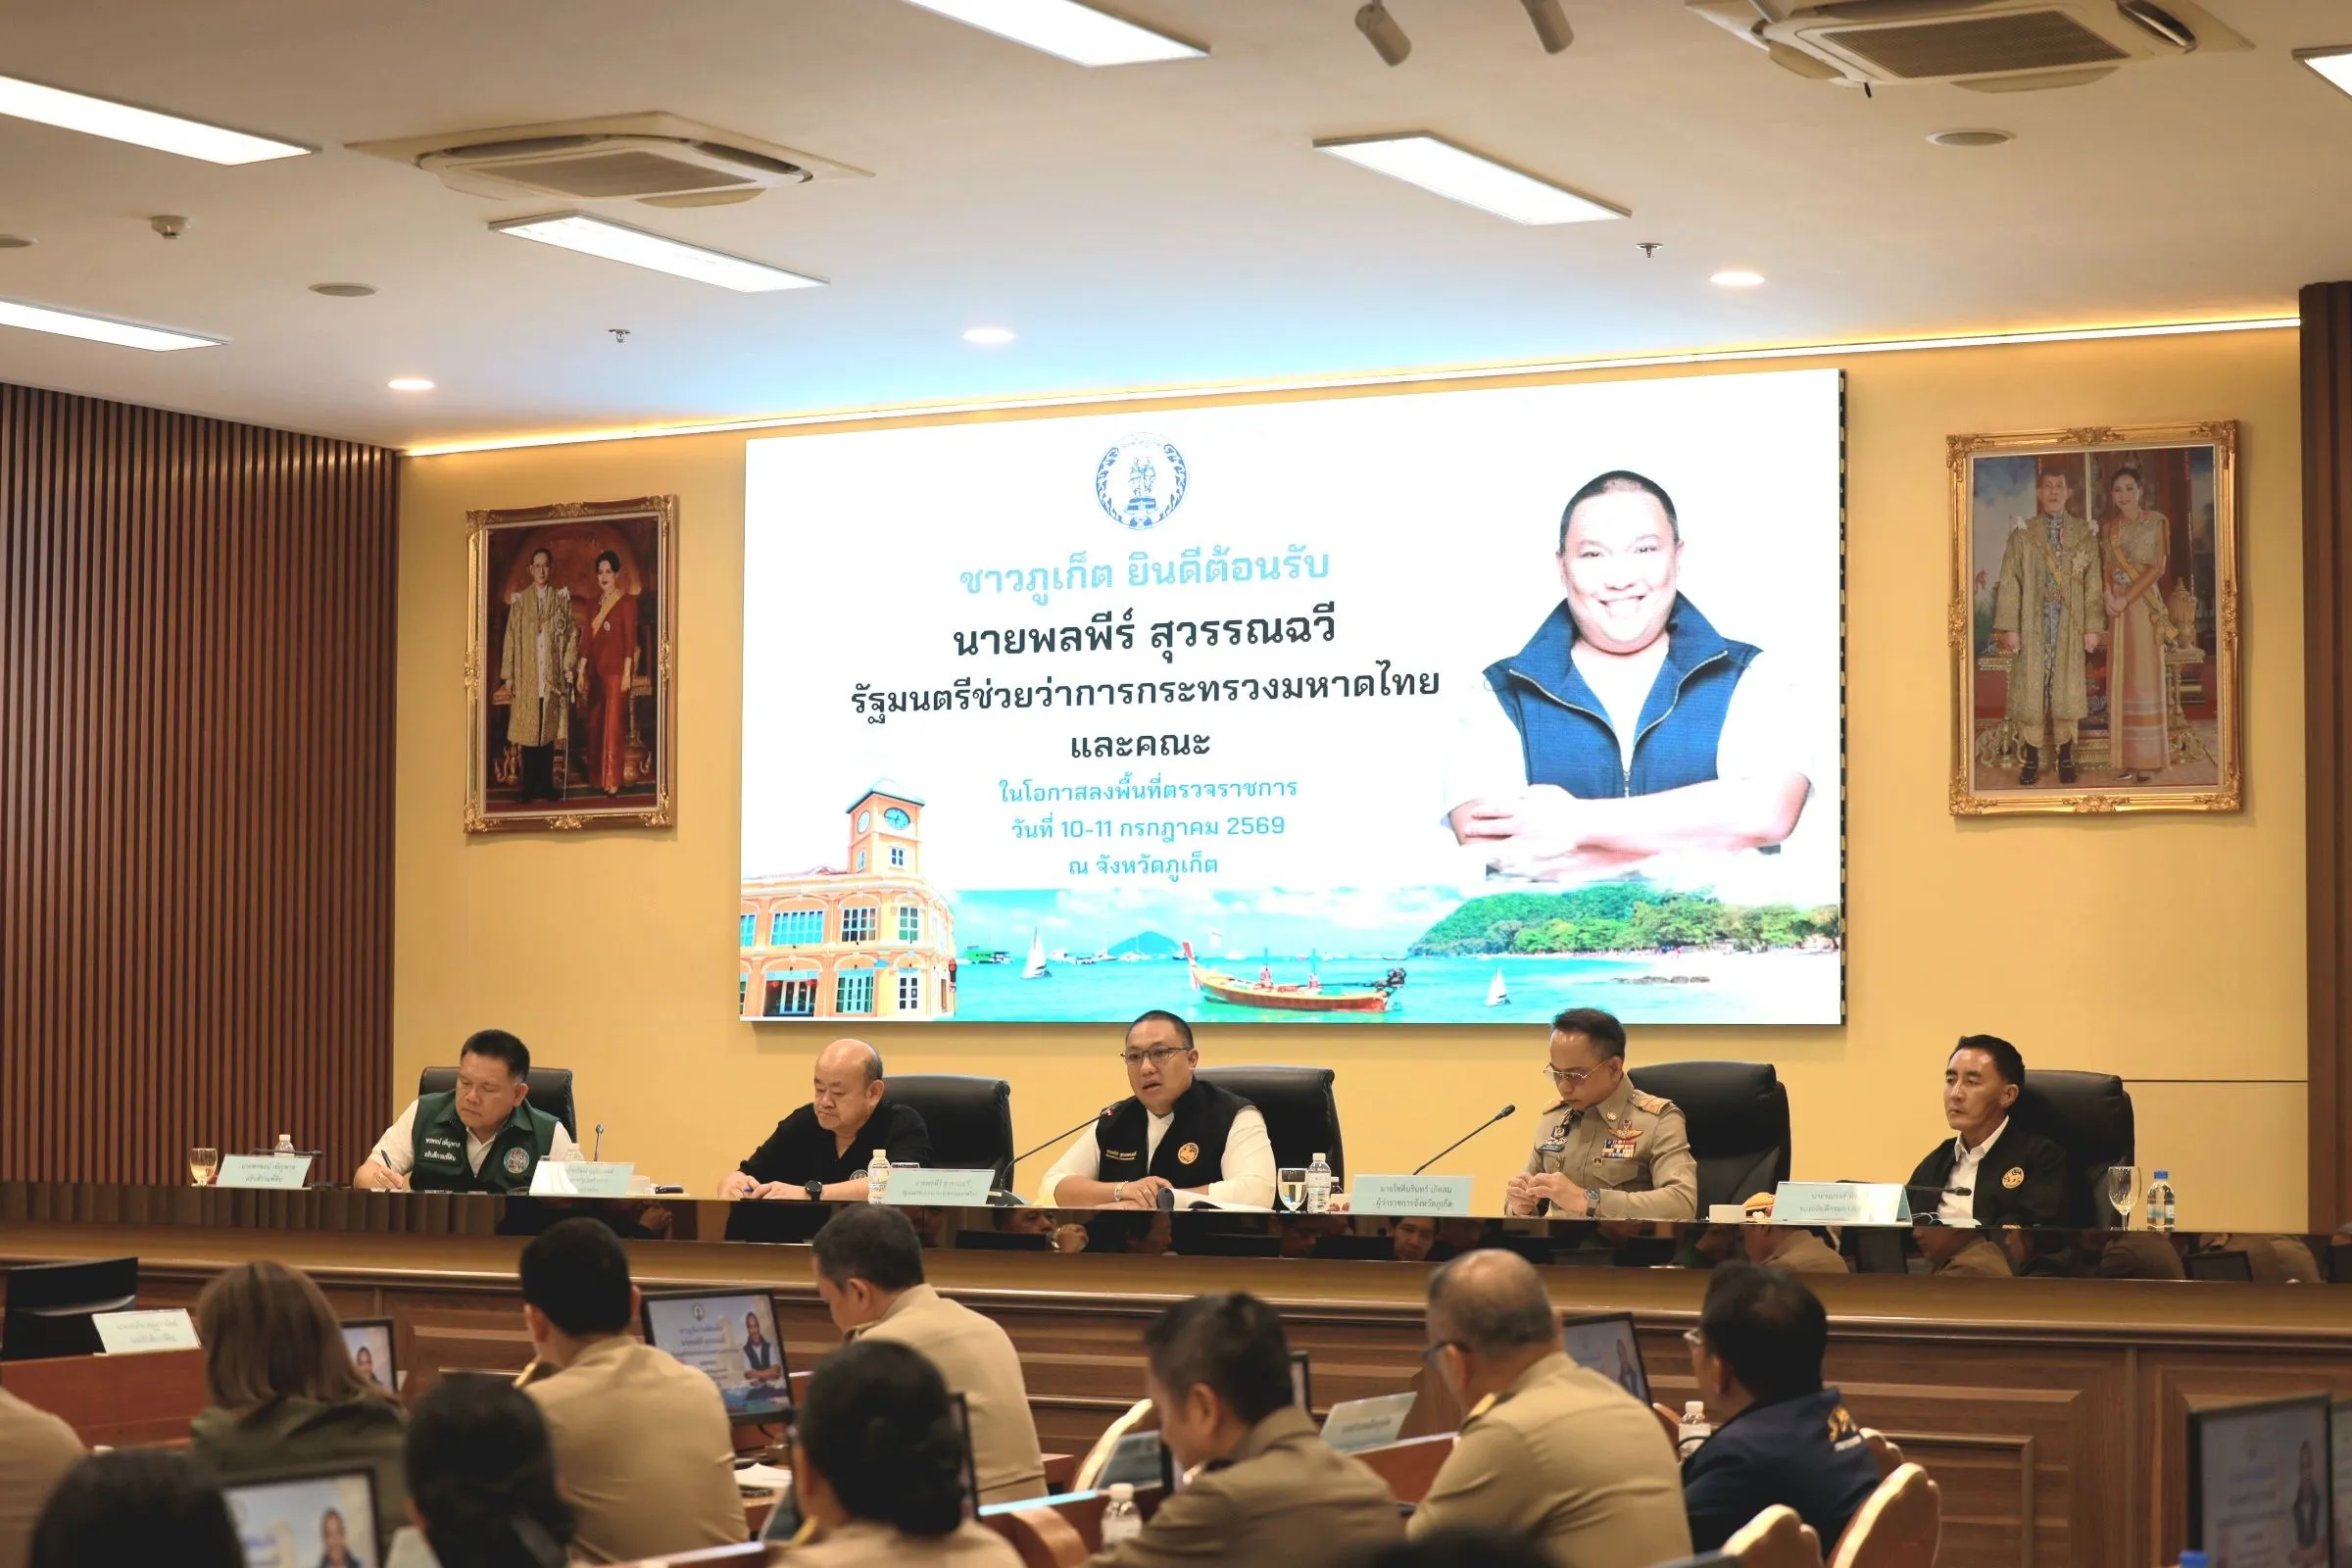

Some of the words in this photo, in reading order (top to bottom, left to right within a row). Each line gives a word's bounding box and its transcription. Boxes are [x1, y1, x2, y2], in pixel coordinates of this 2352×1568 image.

[960, 552, 1113, 607] ชาวภูเก็ต
[1129, 544, 1329, 587] ยินดีต้อนรับ
[954, 607, 1136, 657] นายพลพีร์
[1151, 601, 1335, 664] สุวรรณฉวี
[852, 660, 1440, 725] รัฐมนตรีช่วยว่าการกระทรวงมหาดไทย
[1072, 732, 1211, 759] และคณะ
[999, 772, 1298, 803] ในโอกาสลงพื้นที่ตรวจราชการ
[1011, 812, 1054, 839] วันที่
[1061, 820, 1112, 838] 10-11
[1121, 820, 1220, 844] กรกฎาคม
[1227, 816, 1286, 836] 2569
[1069, 860, 1088, 875] ณ
[1096, 851, 1218, 883] จังหวัดภูเก็ต
